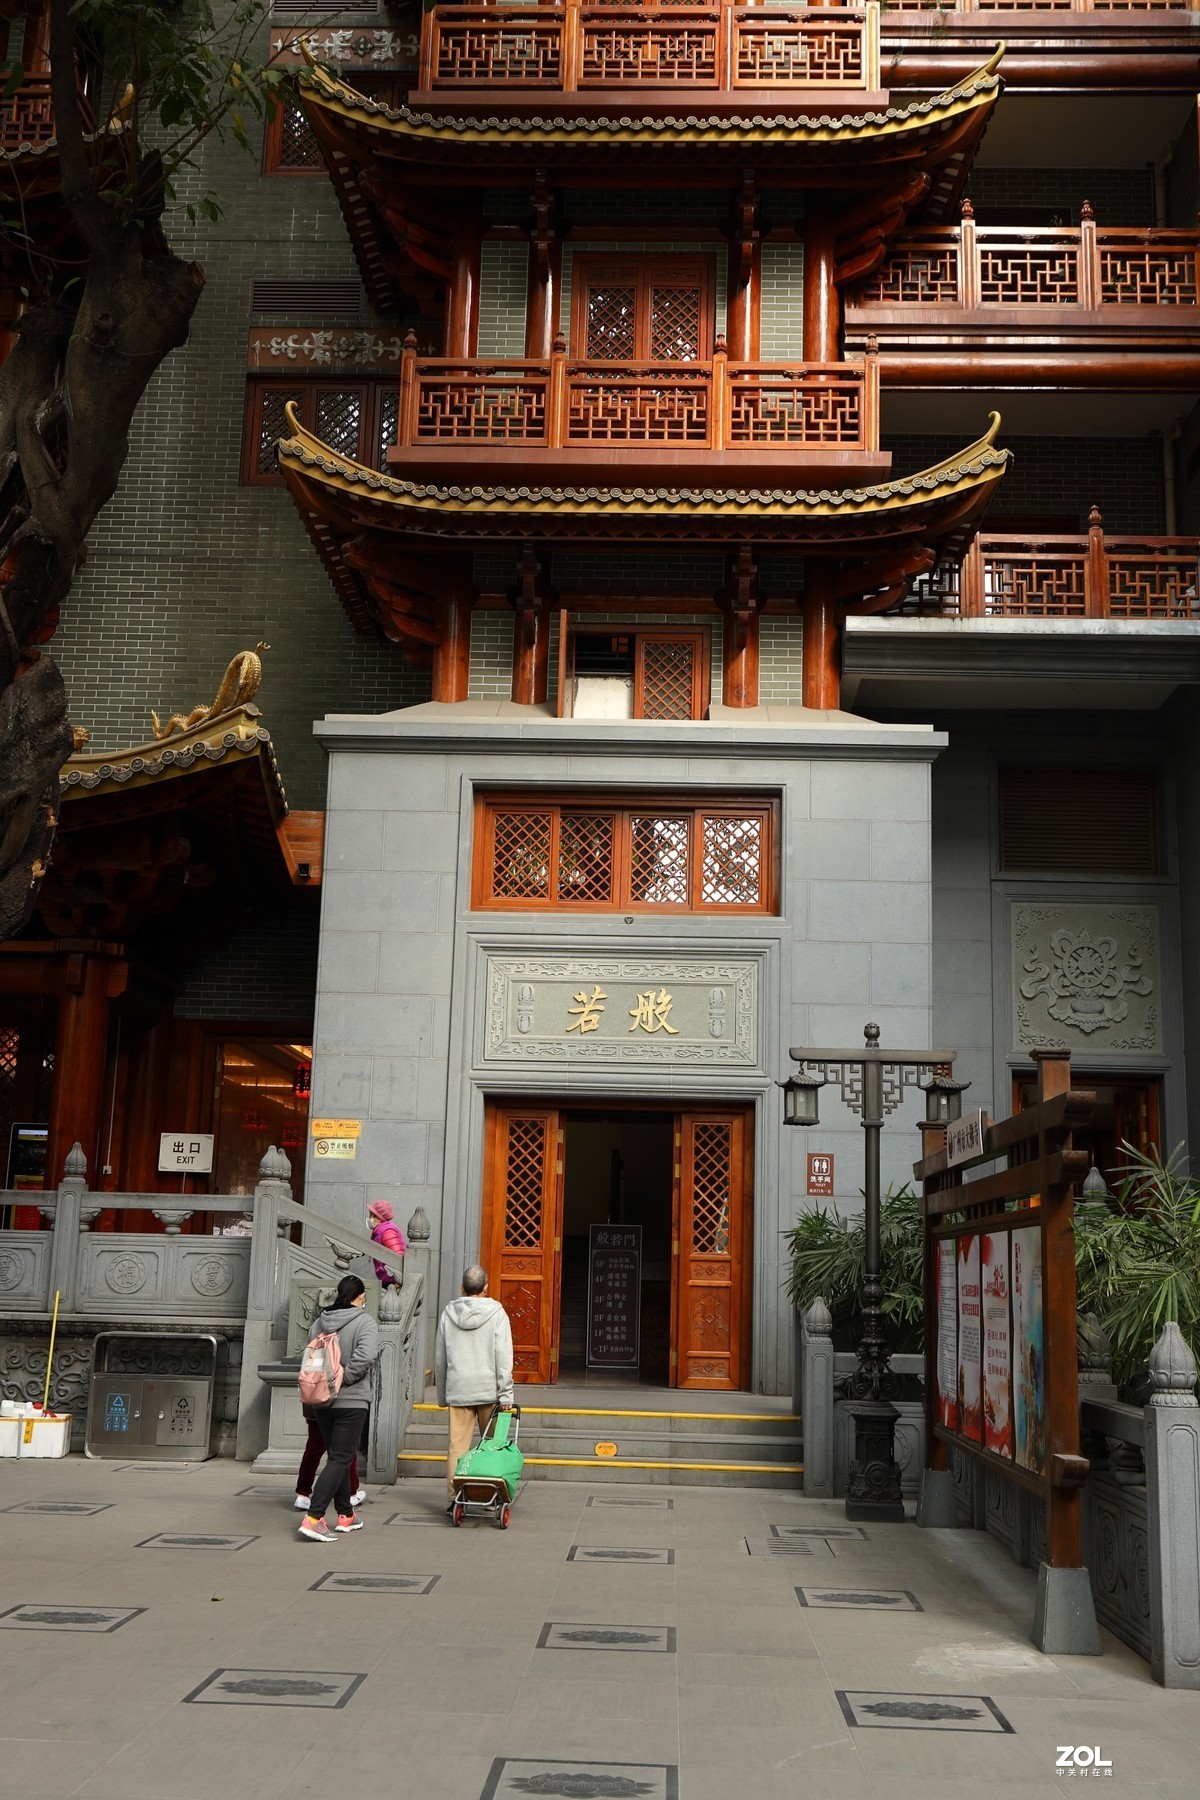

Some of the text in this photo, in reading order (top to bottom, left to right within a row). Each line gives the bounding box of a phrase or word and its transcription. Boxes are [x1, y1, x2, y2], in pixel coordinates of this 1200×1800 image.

[172, 1140, 201, 1154] 出口
[176, 1155, 195, 1164] EXIT
[810, 1175, 831, 1183] 洗手间
[596, 1231, 636, 1247] 般若門
[595, 1275, 605, 1283] 4F
[594, 1295, 604, 1303] 3F
[594, 1314, 604, 1322] 2F
[594, 1329, 604, 1337] 1F
